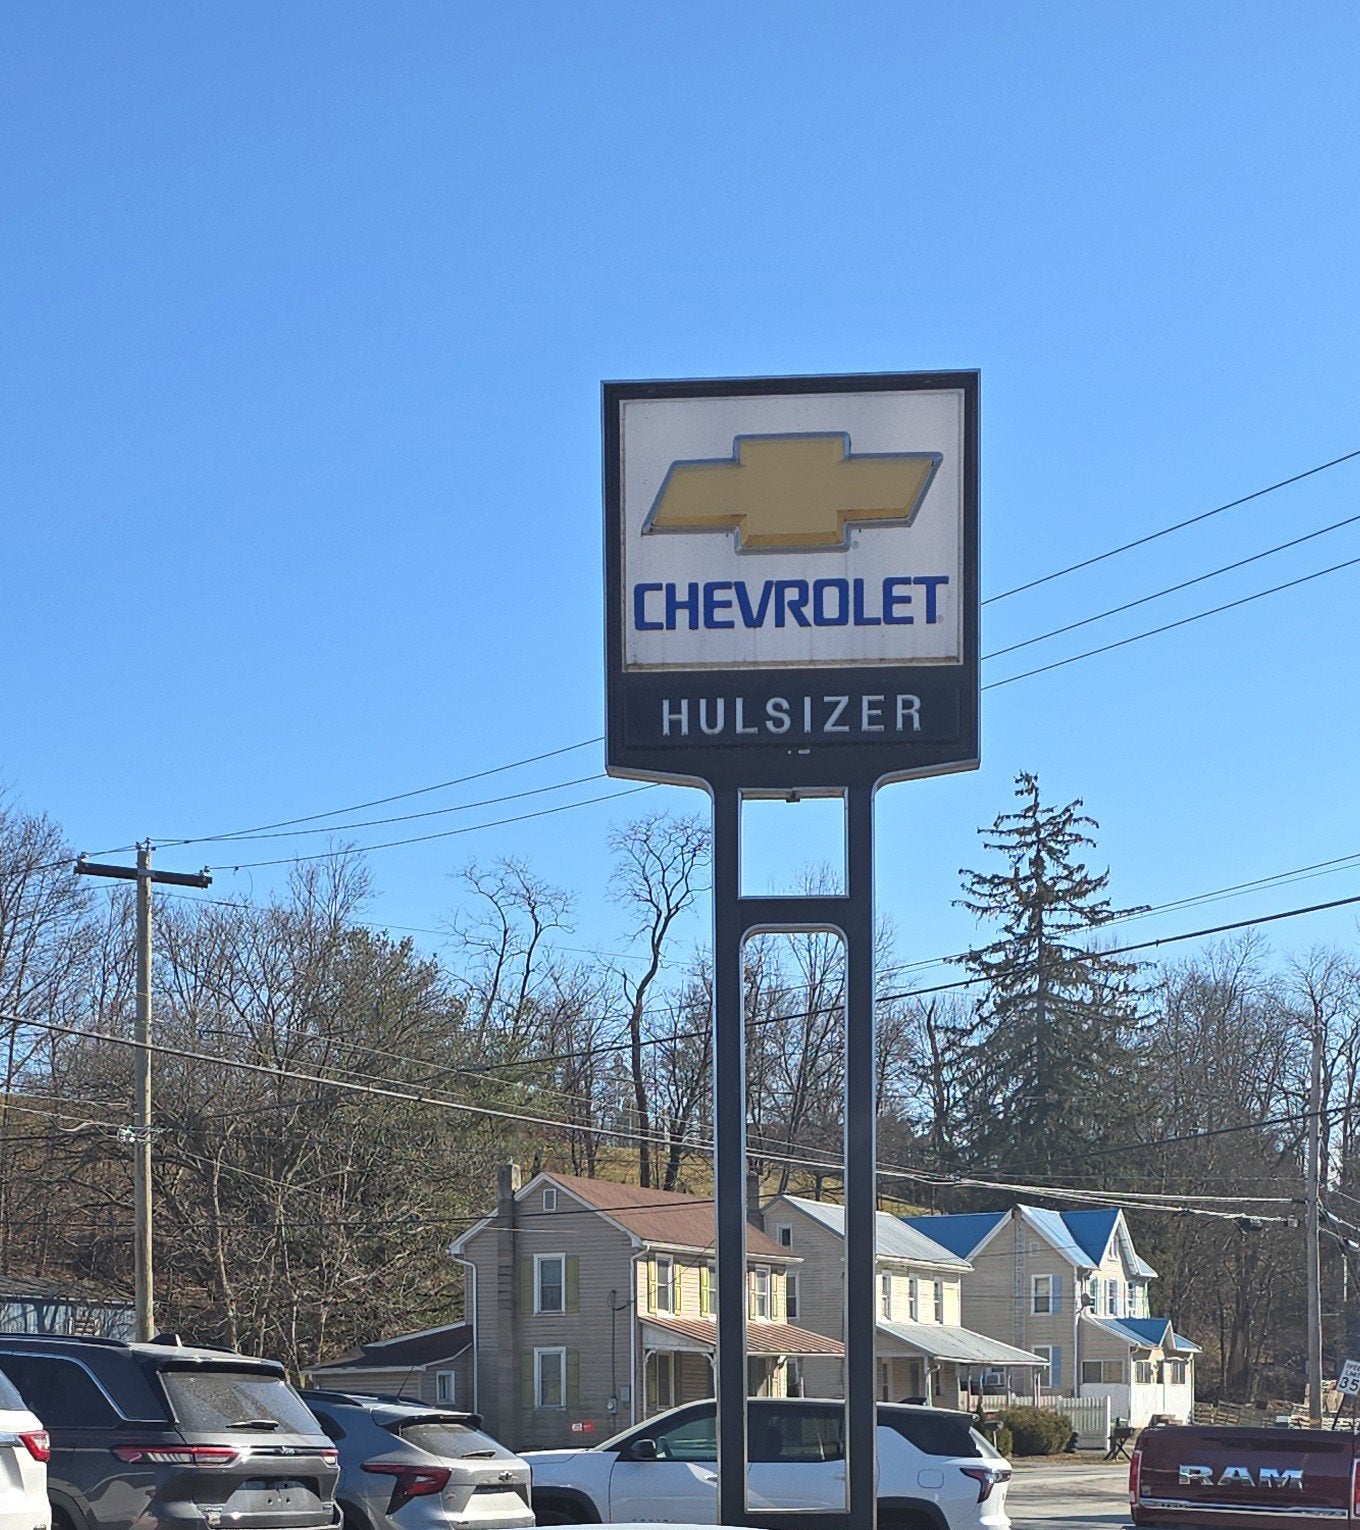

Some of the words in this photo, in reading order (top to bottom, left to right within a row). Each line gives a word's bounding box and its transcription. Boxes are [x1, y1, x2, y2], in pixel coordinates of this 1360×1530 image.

[634, 576, 949, 630] CHEVROLET
[662, 694, 922, 736] HULSIZER
[1339, 1377, 1360, 1391] 35
[1179, 1464, 1304, 1489] RAM
